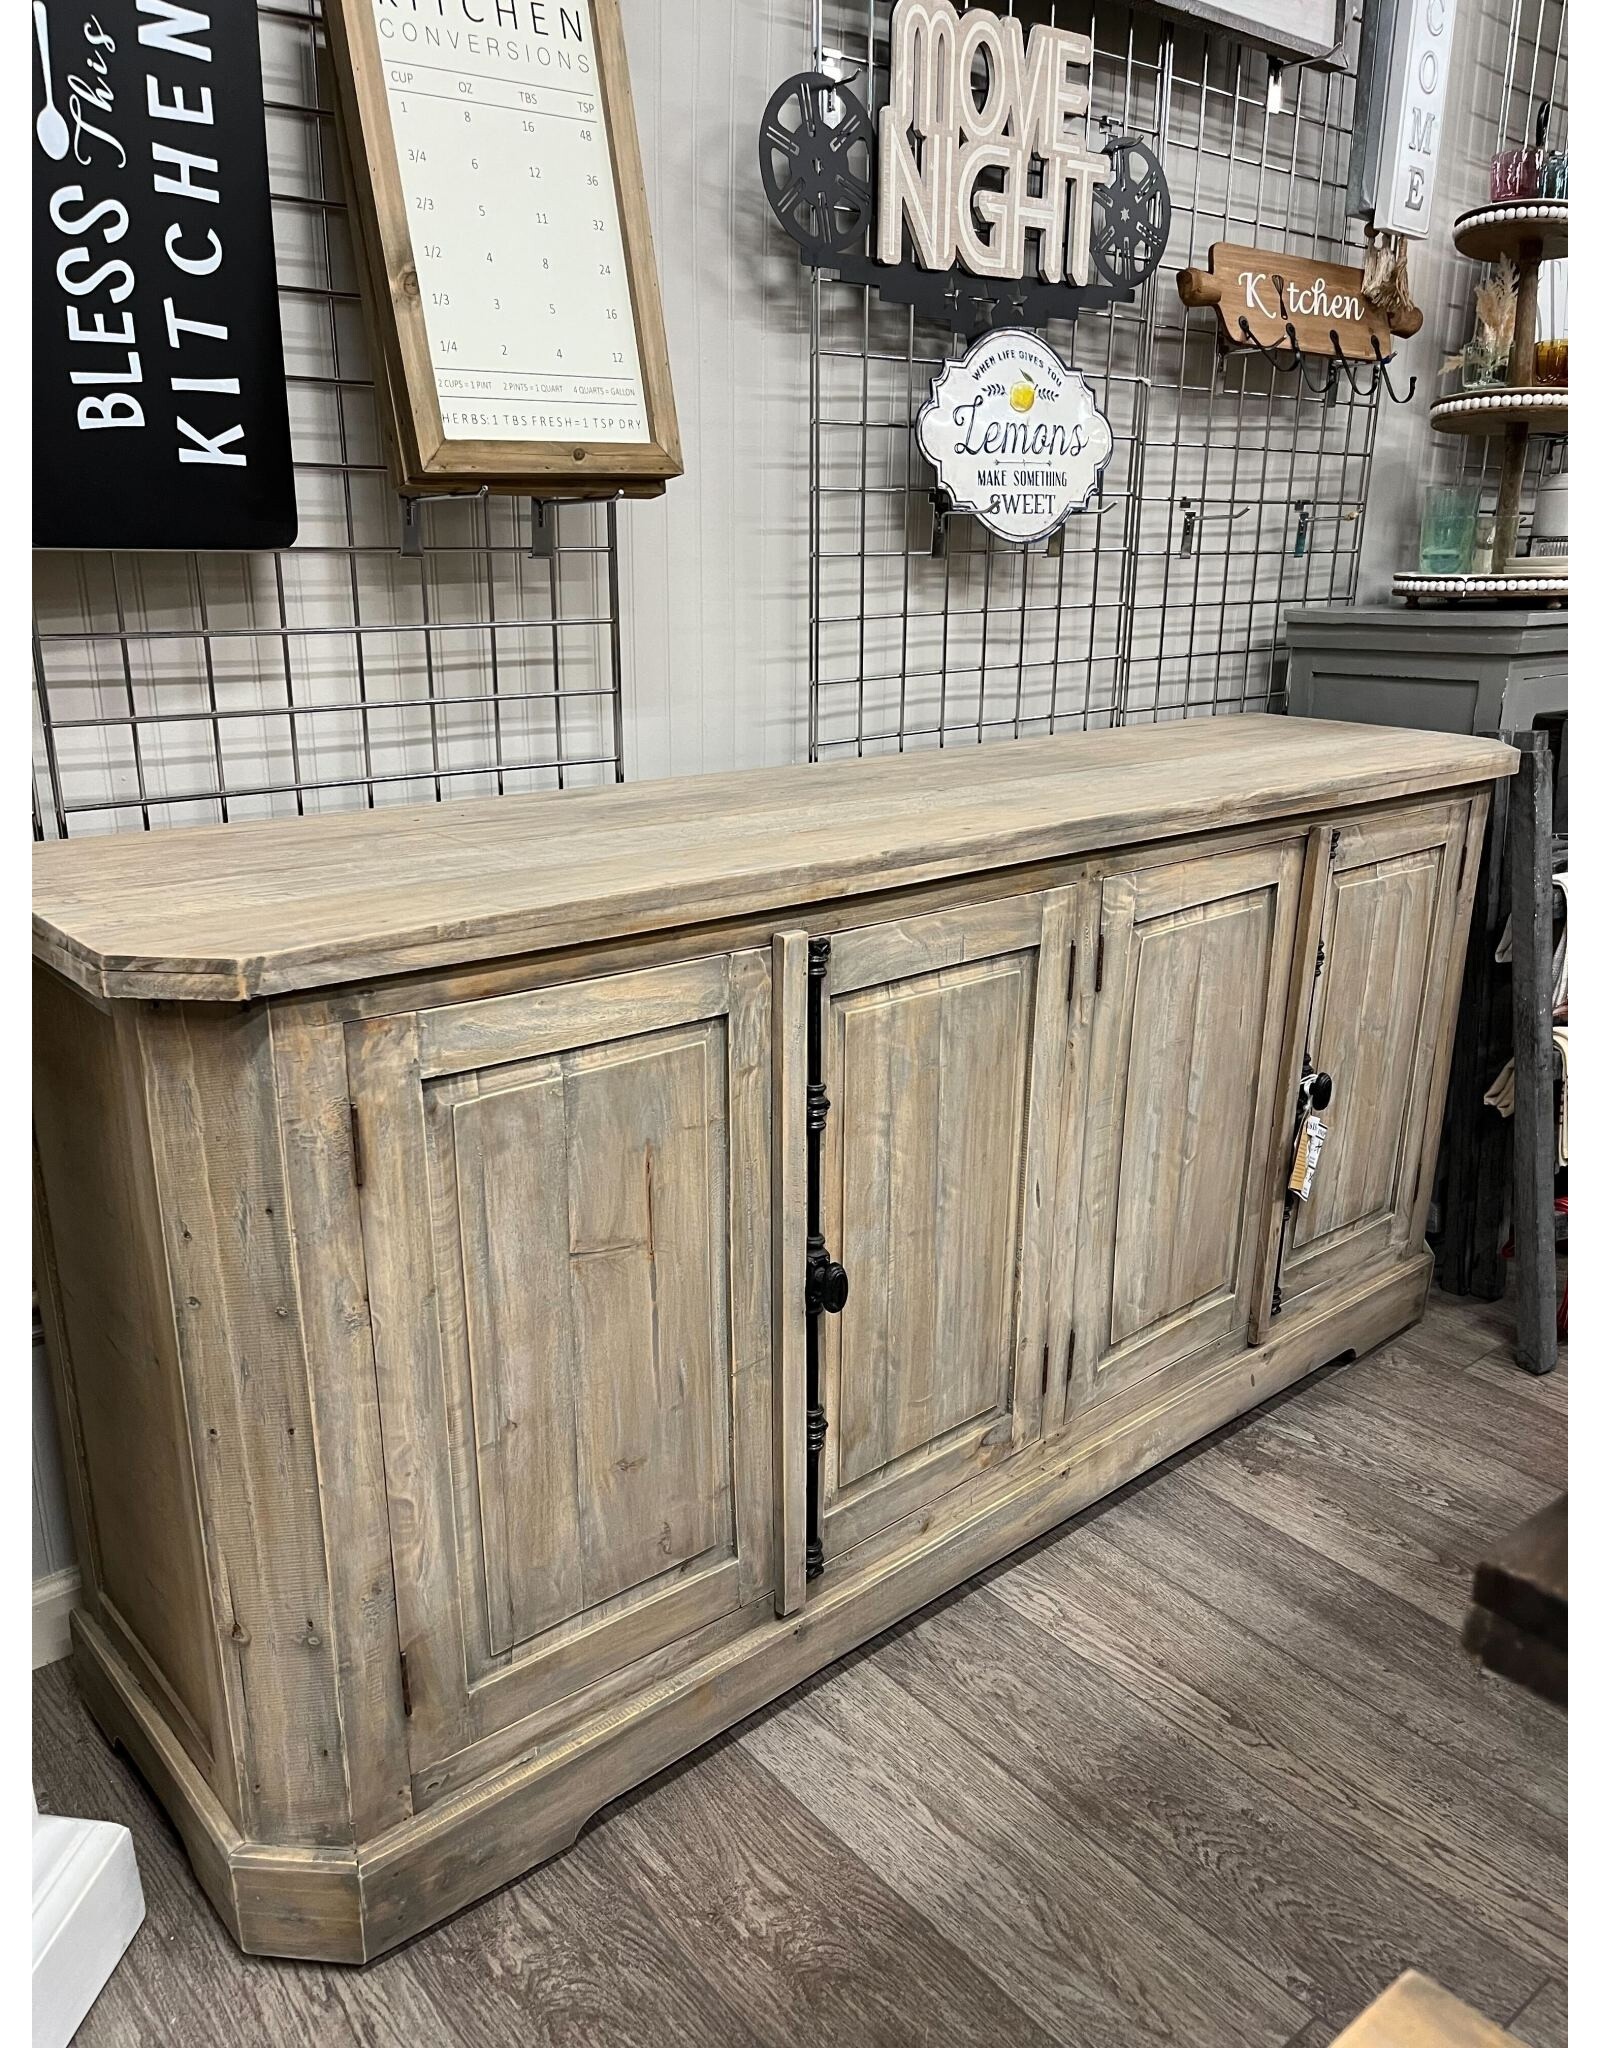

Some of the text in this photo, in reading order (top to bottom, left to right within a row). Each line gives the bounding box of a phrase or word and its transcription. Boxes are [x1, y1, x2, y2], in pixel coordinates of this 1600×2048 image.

[379, 18, 590, 73] CONVERSIONS
[390, 70, 595, 114] CUP OZ TBS TSP
[400, 101, 592, 142] 1 8 16 48
[407, 148, 599, 187] 3/4 6 12 36
[49, 14, 146, 430] BLESS This
[415, 196, 605, 232] 2/3 5 11 32
[135, 0, 247, 466] KITCHEN
[424, 245, 611, 275] 1/2 4 8 24
[432, 292, 618, 320] 1/3 3 5 16
[440, 340, 624, 363] 1/4 2 4 12
[972, 349, 1062, 387] WHEN LIFE GIVES YOU
[445, 379, 463, 389] CUPS
[477, 381, 492, 390] PINT
[509, 382, 528, 392] PINTS
[541, 384, 563, 393] QUART
[579, 386, 604, 396] QUARTS
[611, 388, 635, 396] GALLON
[503, 414, 528, 426] TBS
[592, 418, 614, 428] TSP
[619, 419, 641, 429] DRY
[953, 395, 1090, 456] Lemons
[977, 470, 1068, 487] MAKE SOMETHING
[989, 493, 1056, 515] SWEET
